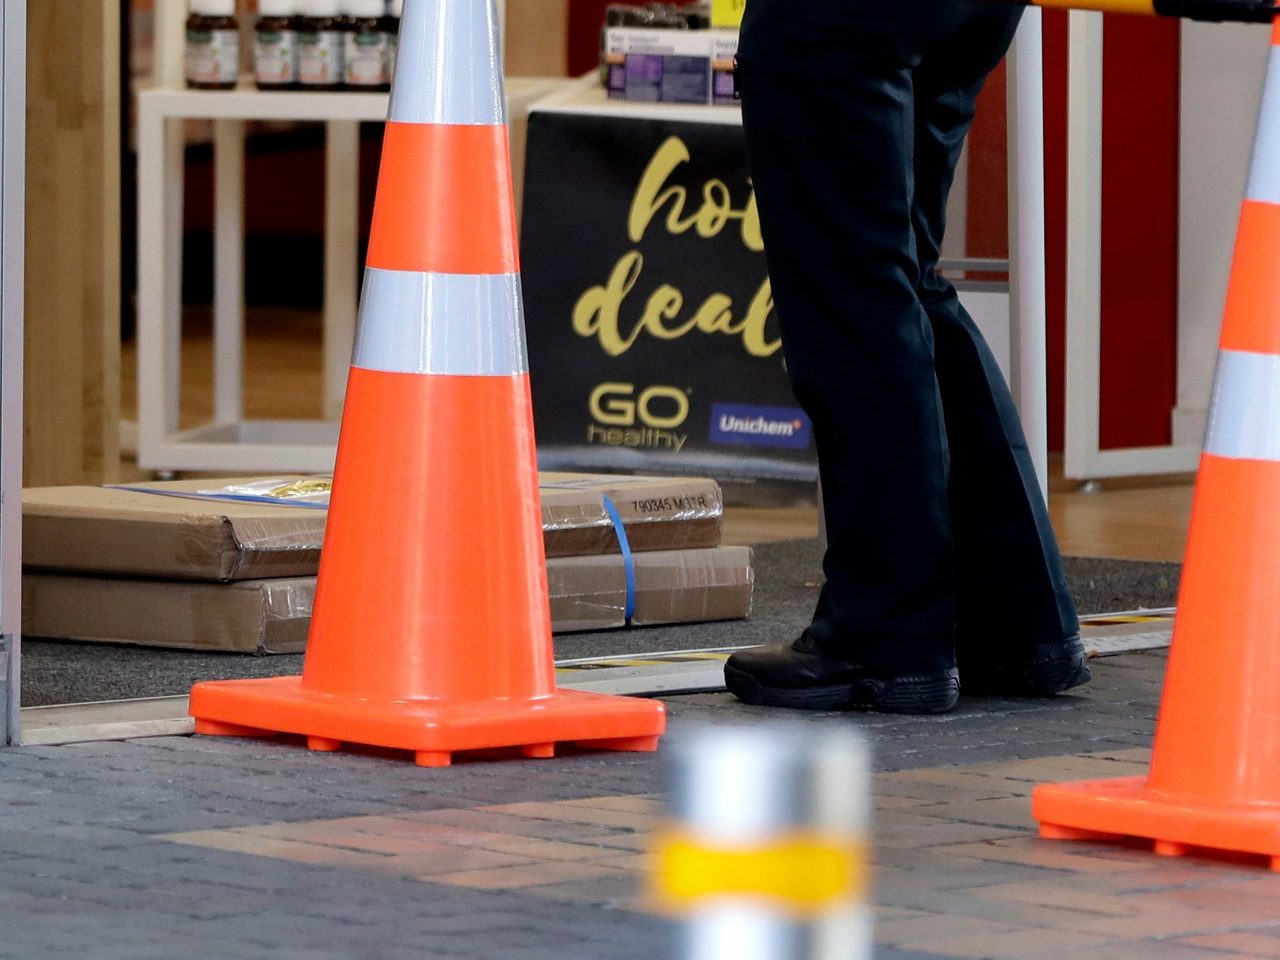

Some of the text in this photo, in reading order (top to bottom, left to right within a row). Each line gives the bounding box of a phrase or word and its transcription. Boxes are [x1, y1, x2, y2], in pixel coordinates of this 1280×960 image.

[572, 249, 785, 358] deal
[588, 382, 690, 428] GO
[587, 423, 688, 454] healthy
[719, 414, 796, 437] Unichem
[631, 498, 672, 513] 790345
